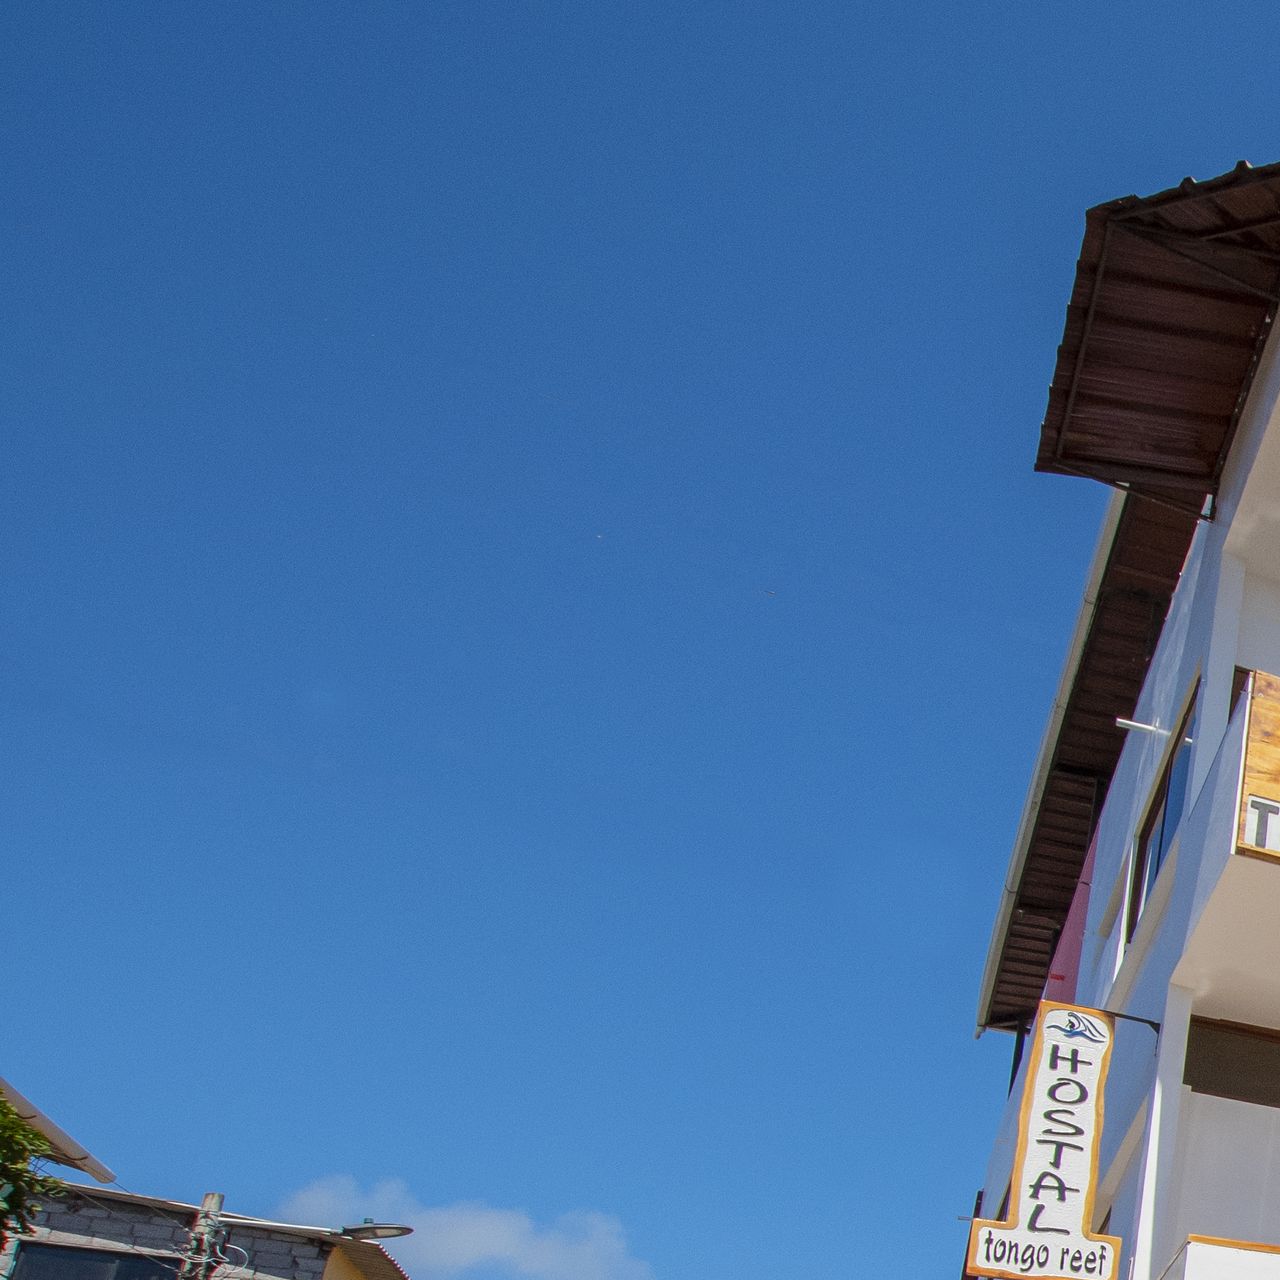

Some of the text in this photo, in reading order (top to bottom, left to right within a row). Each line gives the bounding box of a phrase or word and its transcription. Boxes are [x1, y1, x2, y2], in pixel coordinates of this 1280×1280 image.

[1027, 1043, 1093, 1235] HOSTAL
[984, 1230, 1107, 1275] tongo reef
